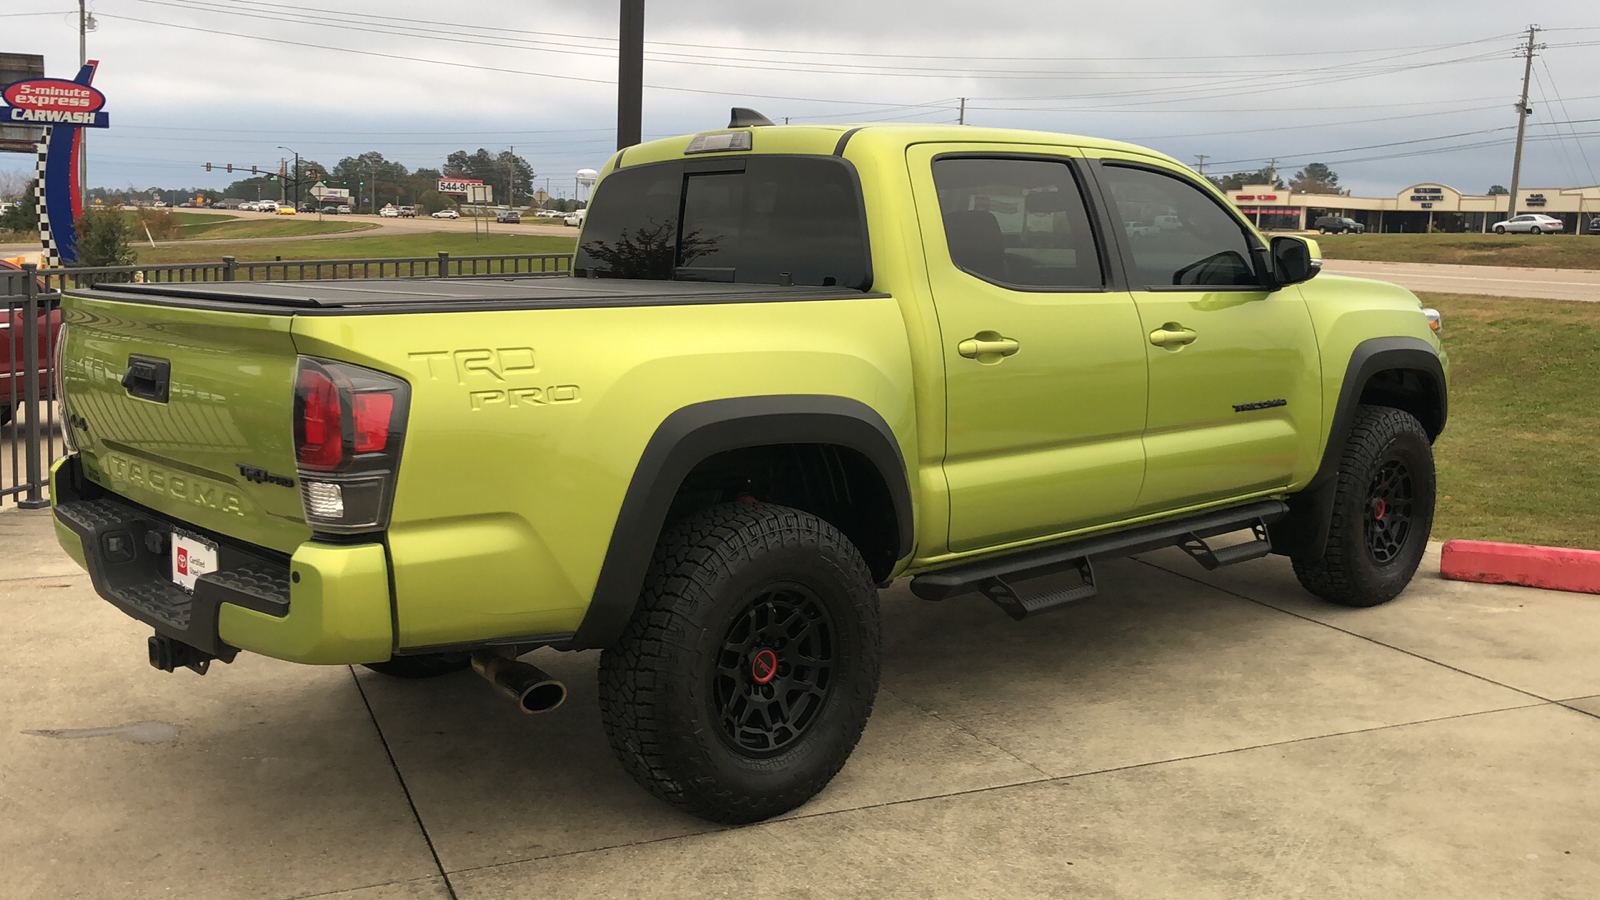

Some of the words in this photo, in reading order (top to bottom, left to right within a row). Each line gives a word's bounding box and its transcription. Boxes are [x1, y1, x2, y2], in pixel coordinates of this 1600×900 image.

[15, 95, 90, 107] express
[20, 85, 90, 97] 5-minute
[11, 108, 95, 124] CARWASH
[407, 346, 540, 385] TRD
[469, 384, 583, 411] PRO
[111, 455, 244, 516] TACOMA
